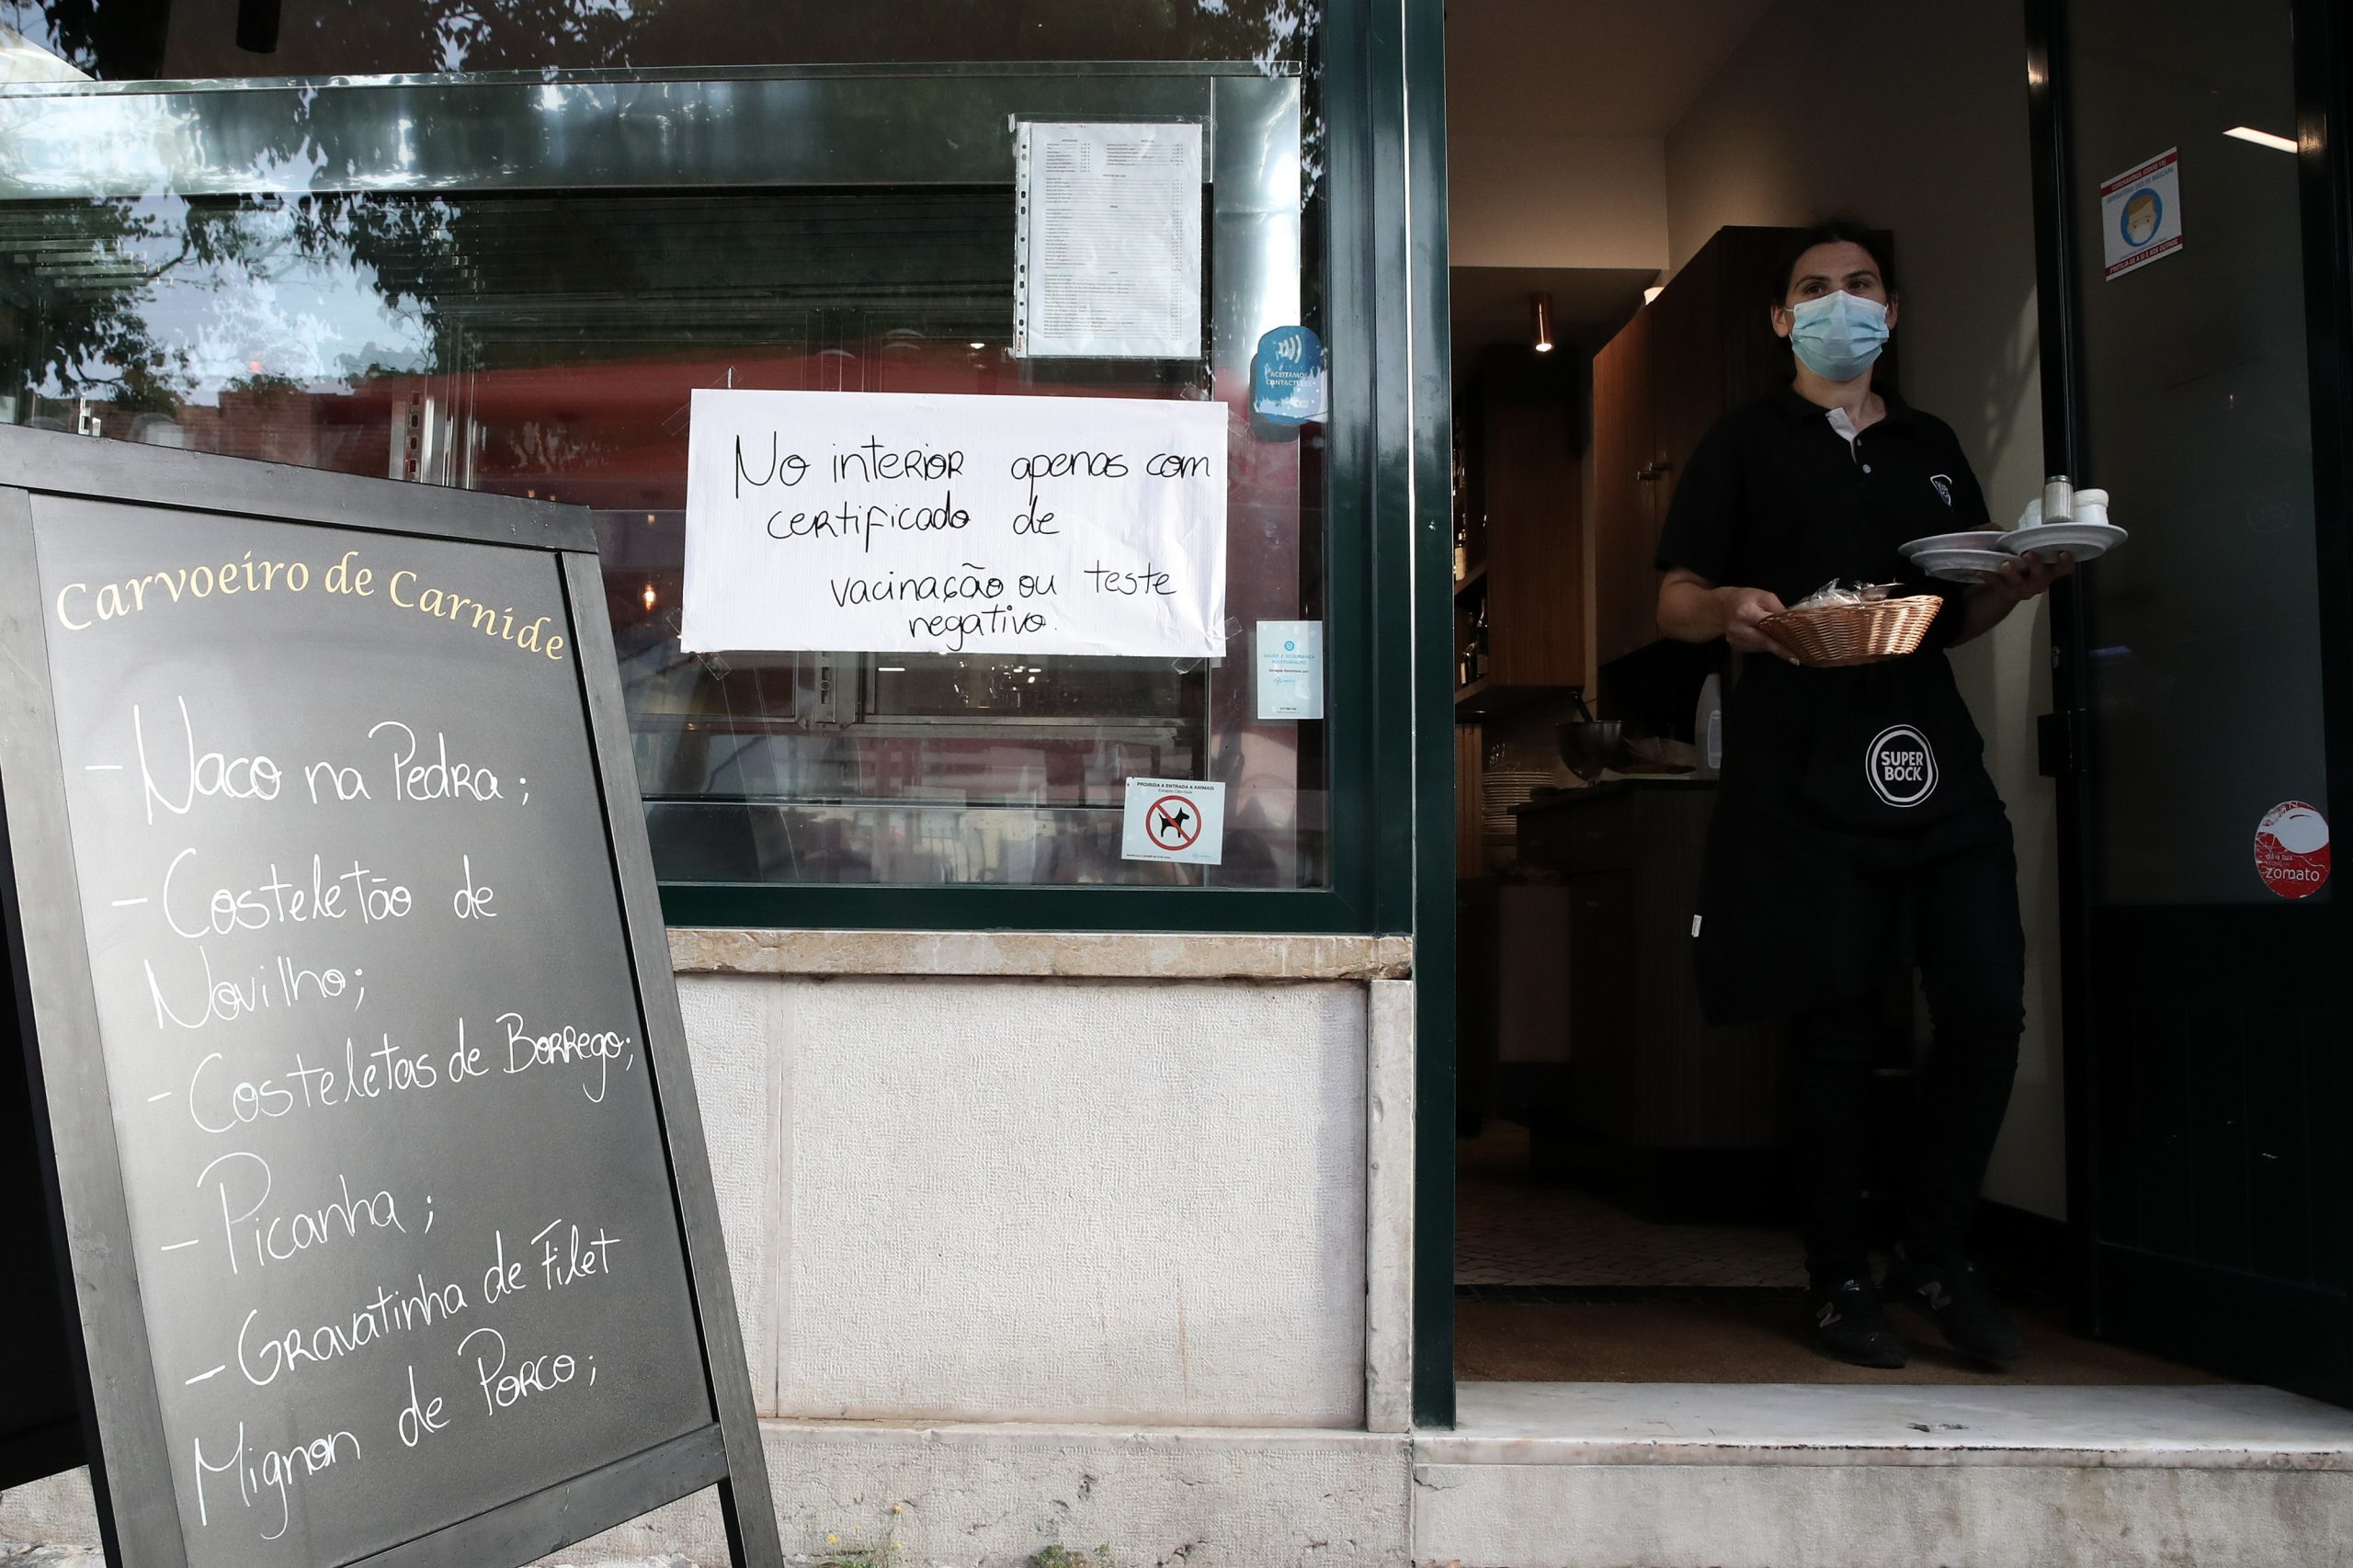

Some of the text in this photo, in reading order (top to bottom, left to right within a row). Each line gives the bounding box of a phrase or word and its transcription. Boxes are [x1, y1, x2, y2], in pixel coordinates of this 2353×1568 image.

[735, 431, 811, 499] No
[1010, 449, 1131, 504] apenas
[1145, 450, 1211, 479] com
[767, 490, 1061, 553] certificado de
[56, 550, 565, 661] Carvoeiro de Carnide
[830, 559, 1177, 608] vacinação ou teste
[133, 695, 283, 826] Naco
[304, 760, 372, 805] na
[1881, 751, 1924, 766] SUPER
[1884, 766, 1923, 781] BOCK
[163, 848, 413, 939] Costeletão
[453, 855, 499, 921] de
[2266, 868, 2320, 881] zomato
[189, 1032, 438, 1133] Costeletas
[449, 1017, 490, 1085] de
[483, 1229, 529, 1305] de
[530, 1218, 622, 1290] Filet
[193, 1421, 361, 1540] Mignon
[398, 1366, 452, 1448] de
